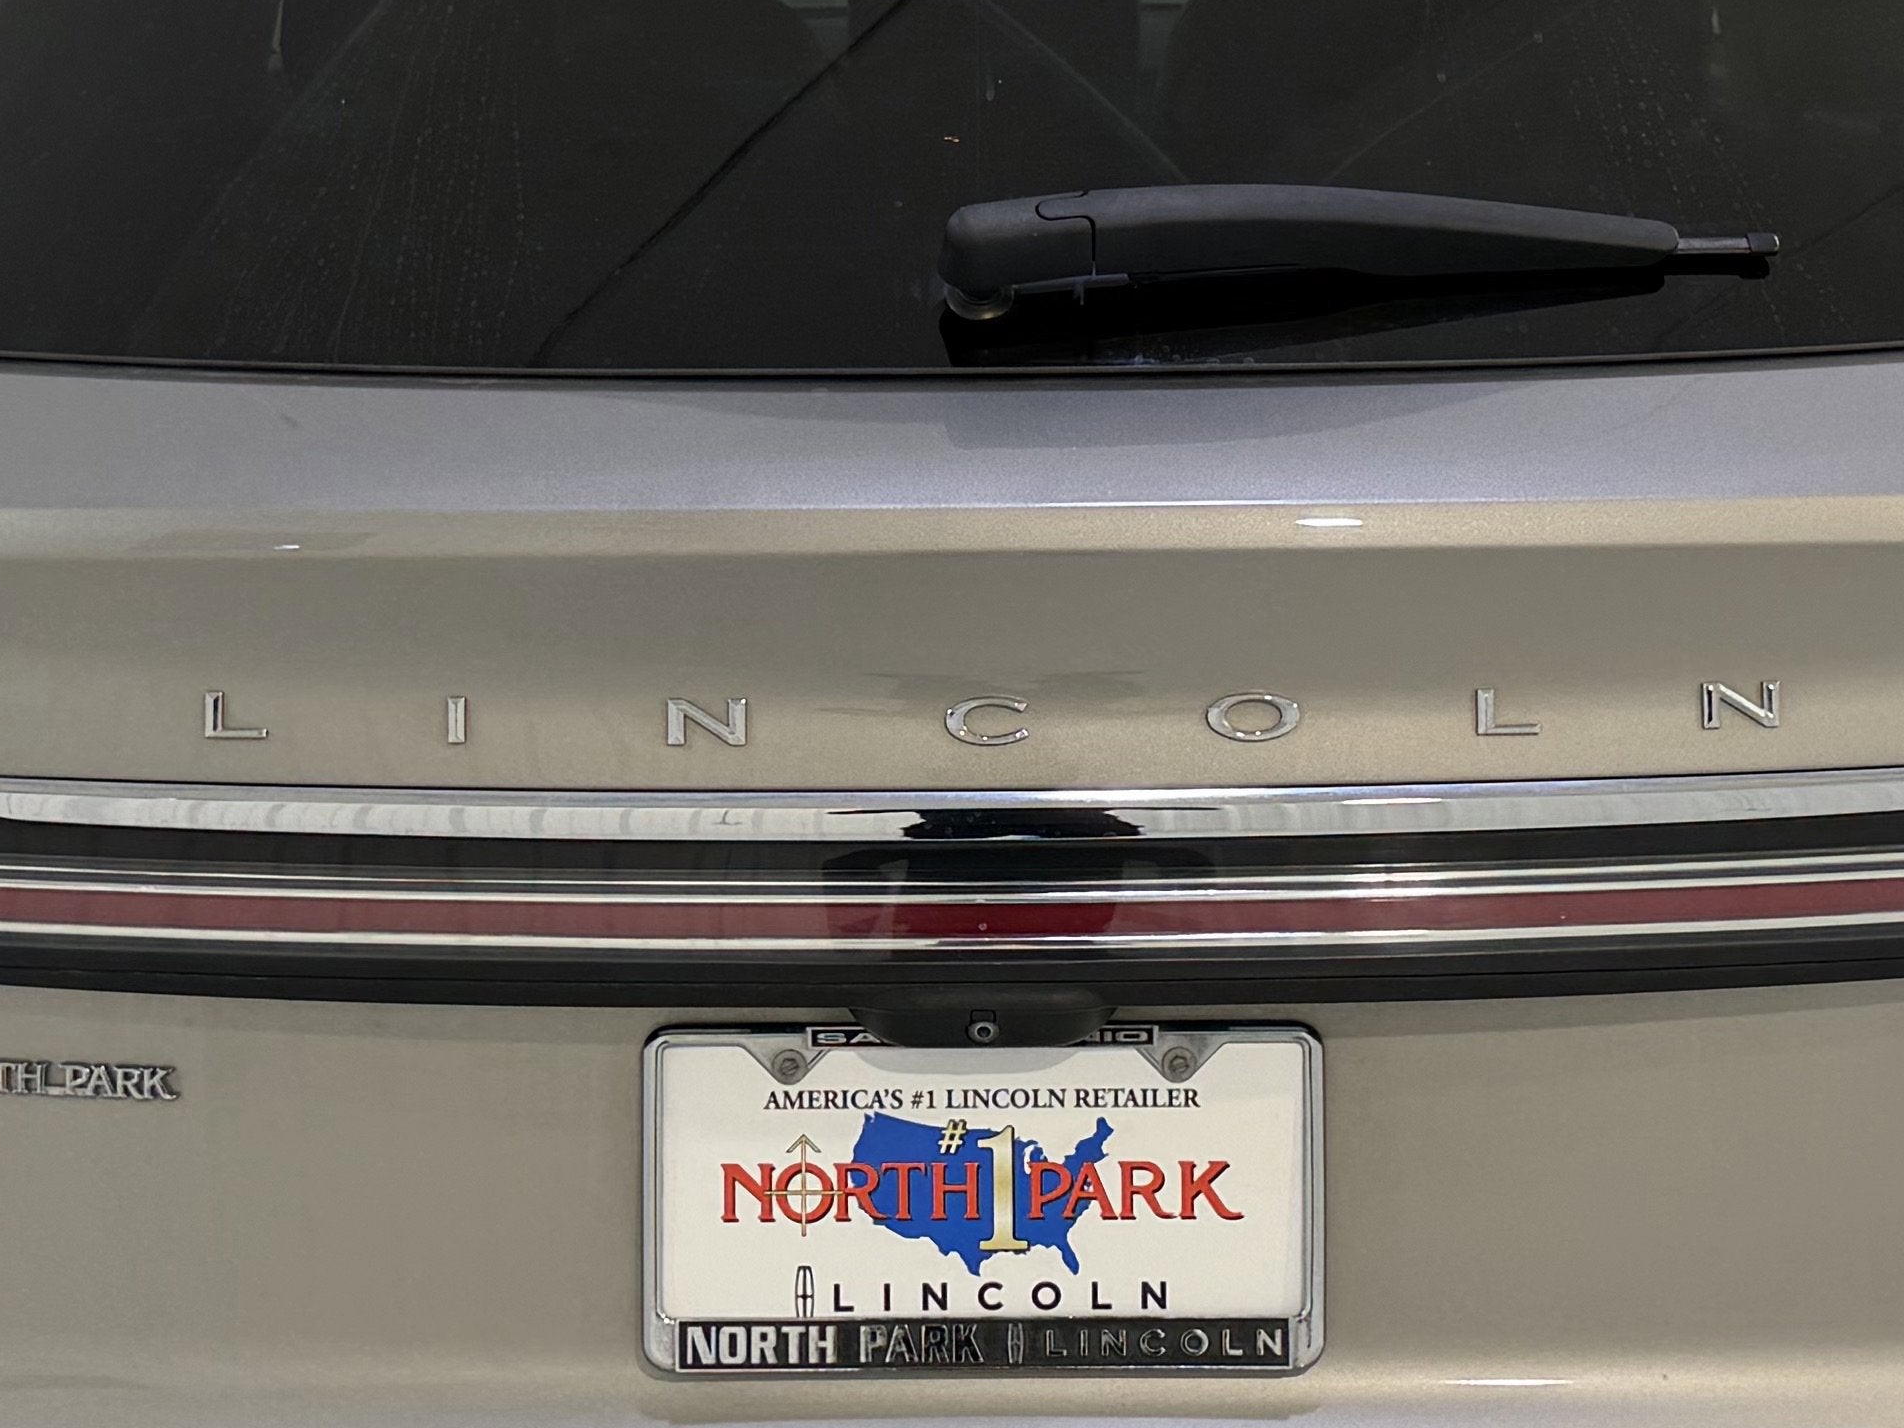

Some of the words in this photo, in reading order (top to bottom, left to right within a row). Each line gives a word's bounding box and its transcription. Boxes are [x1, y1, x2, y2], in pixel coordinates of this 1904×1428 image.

[204, 679, 1781, 747] LINCOLN
[59, 1062, 178, 1102] PARK
[764, 1088, 903, 1110] AMERICA'S
[910, 1088, 937, 1110] #1
[945, 1088, 1067, 1109] LINCOLN
[1073, 1088, 1201, 1109] RETAILER
[720, 1161, 983, 1224] NORTH
[1027, 1160, 1245, 1221] PARK
[834, 1281, 1168, 1312] LINCOLN
[686, 1325, 836, 1366] NORTH
[859, 1324, 985, 1364] PARK
[1045, 1327, 1284, 1358] LINCOLN
